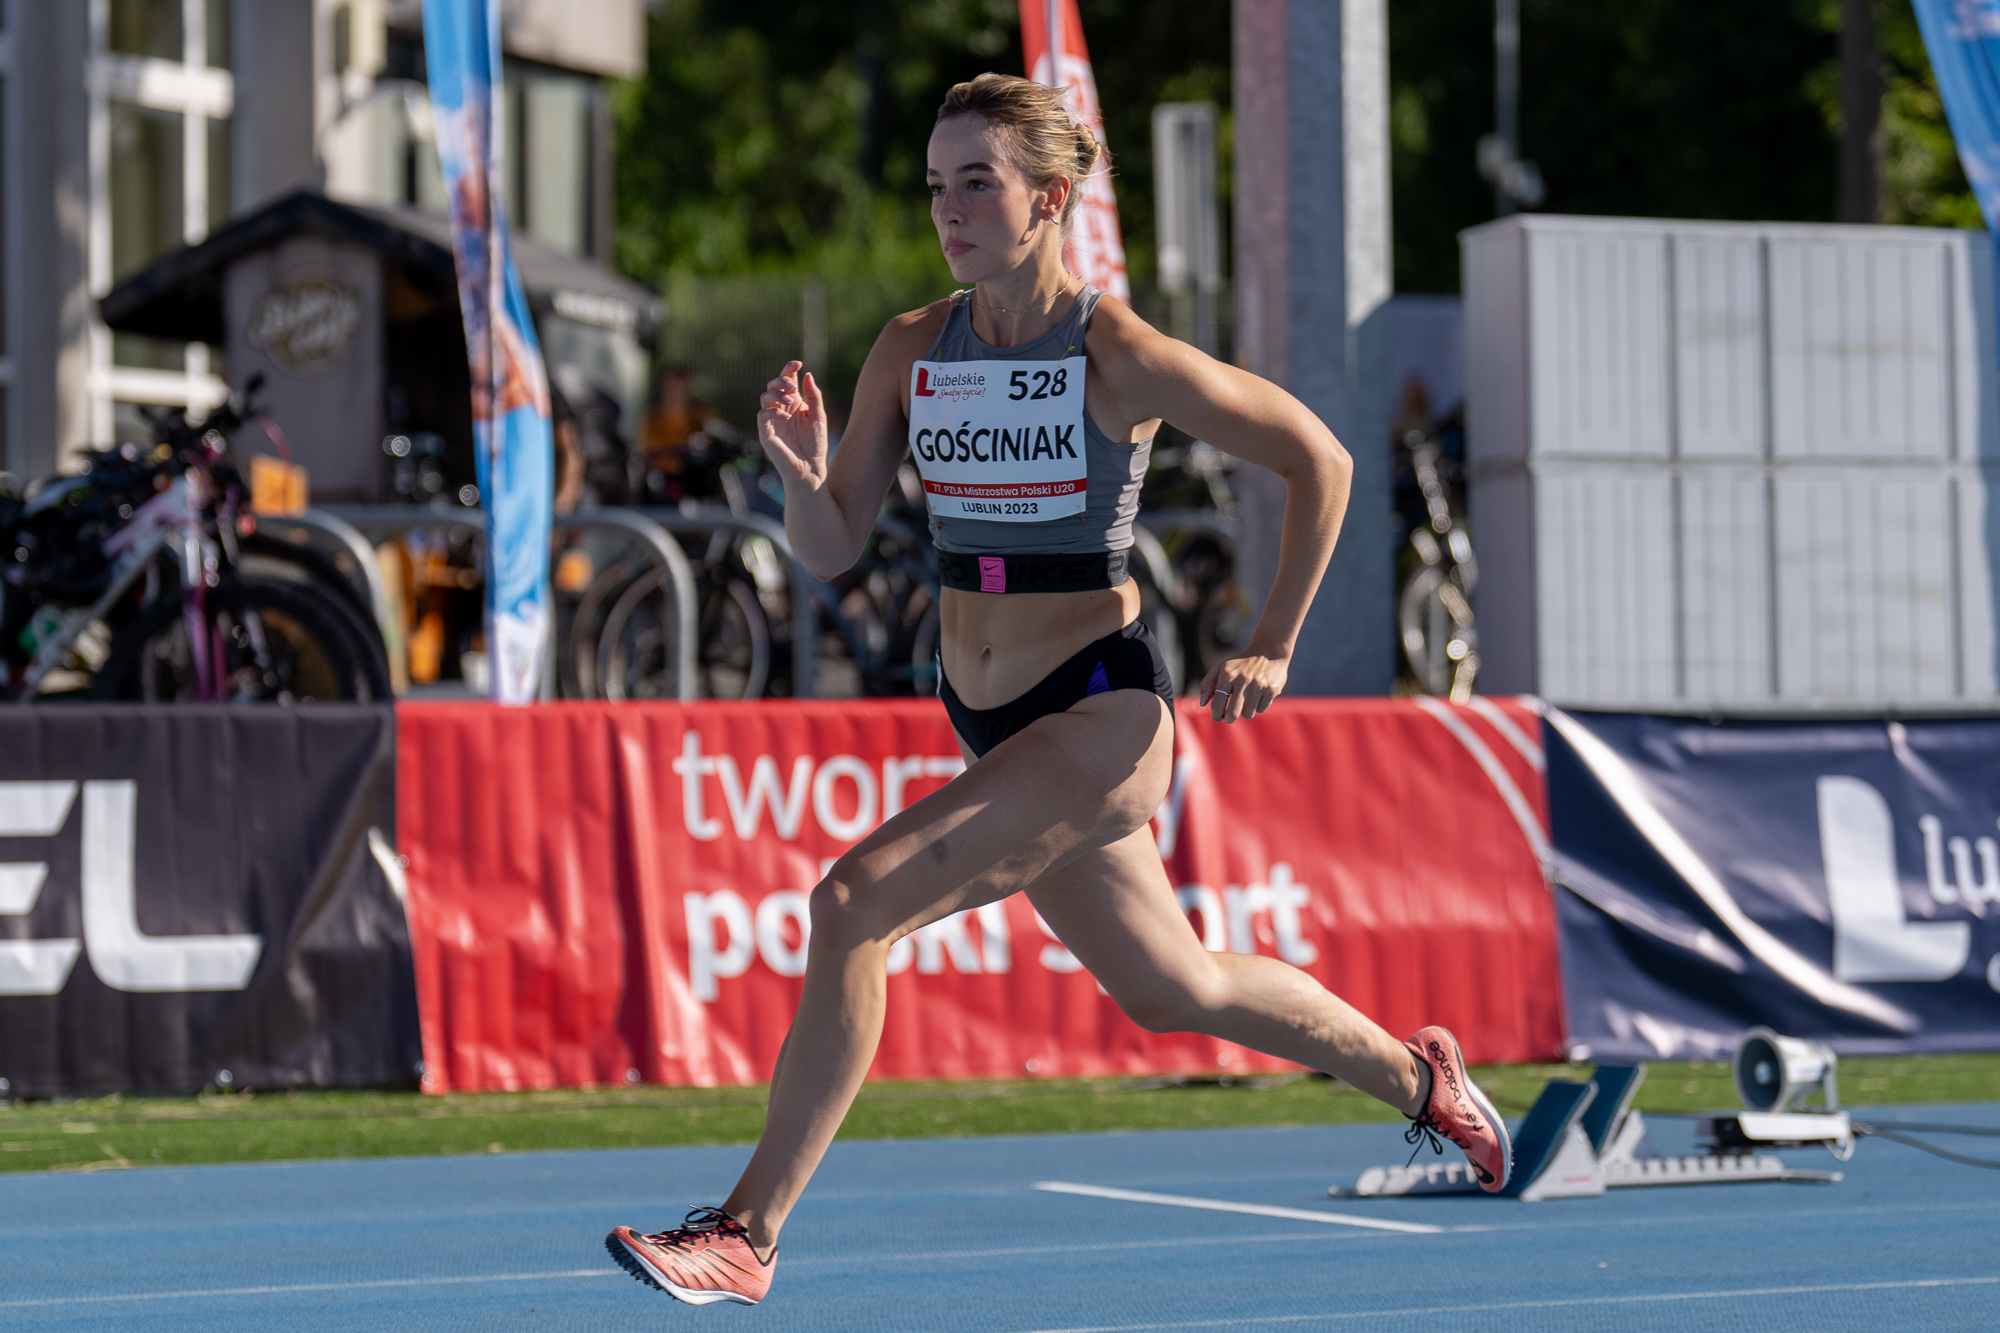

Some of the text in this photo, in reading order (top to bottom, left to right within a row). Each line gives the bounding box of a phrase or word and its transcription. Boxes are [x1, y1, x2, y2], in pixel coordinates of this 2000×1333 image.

[1008, 367, 1067, 401] 528
[916, 421, 1078, 463] GOŚCINIAK
[961, 501, 1039, 515] LUBLIN 2023
[964, 485, 1019, 497] Mistrzostwa
[1021, 485, 1052, 496] Polski
[1054, 483, 1075, 494] U20
[1919, 813, 2000, 905] lu
[1429, 1040, 1462, 1103] balance
